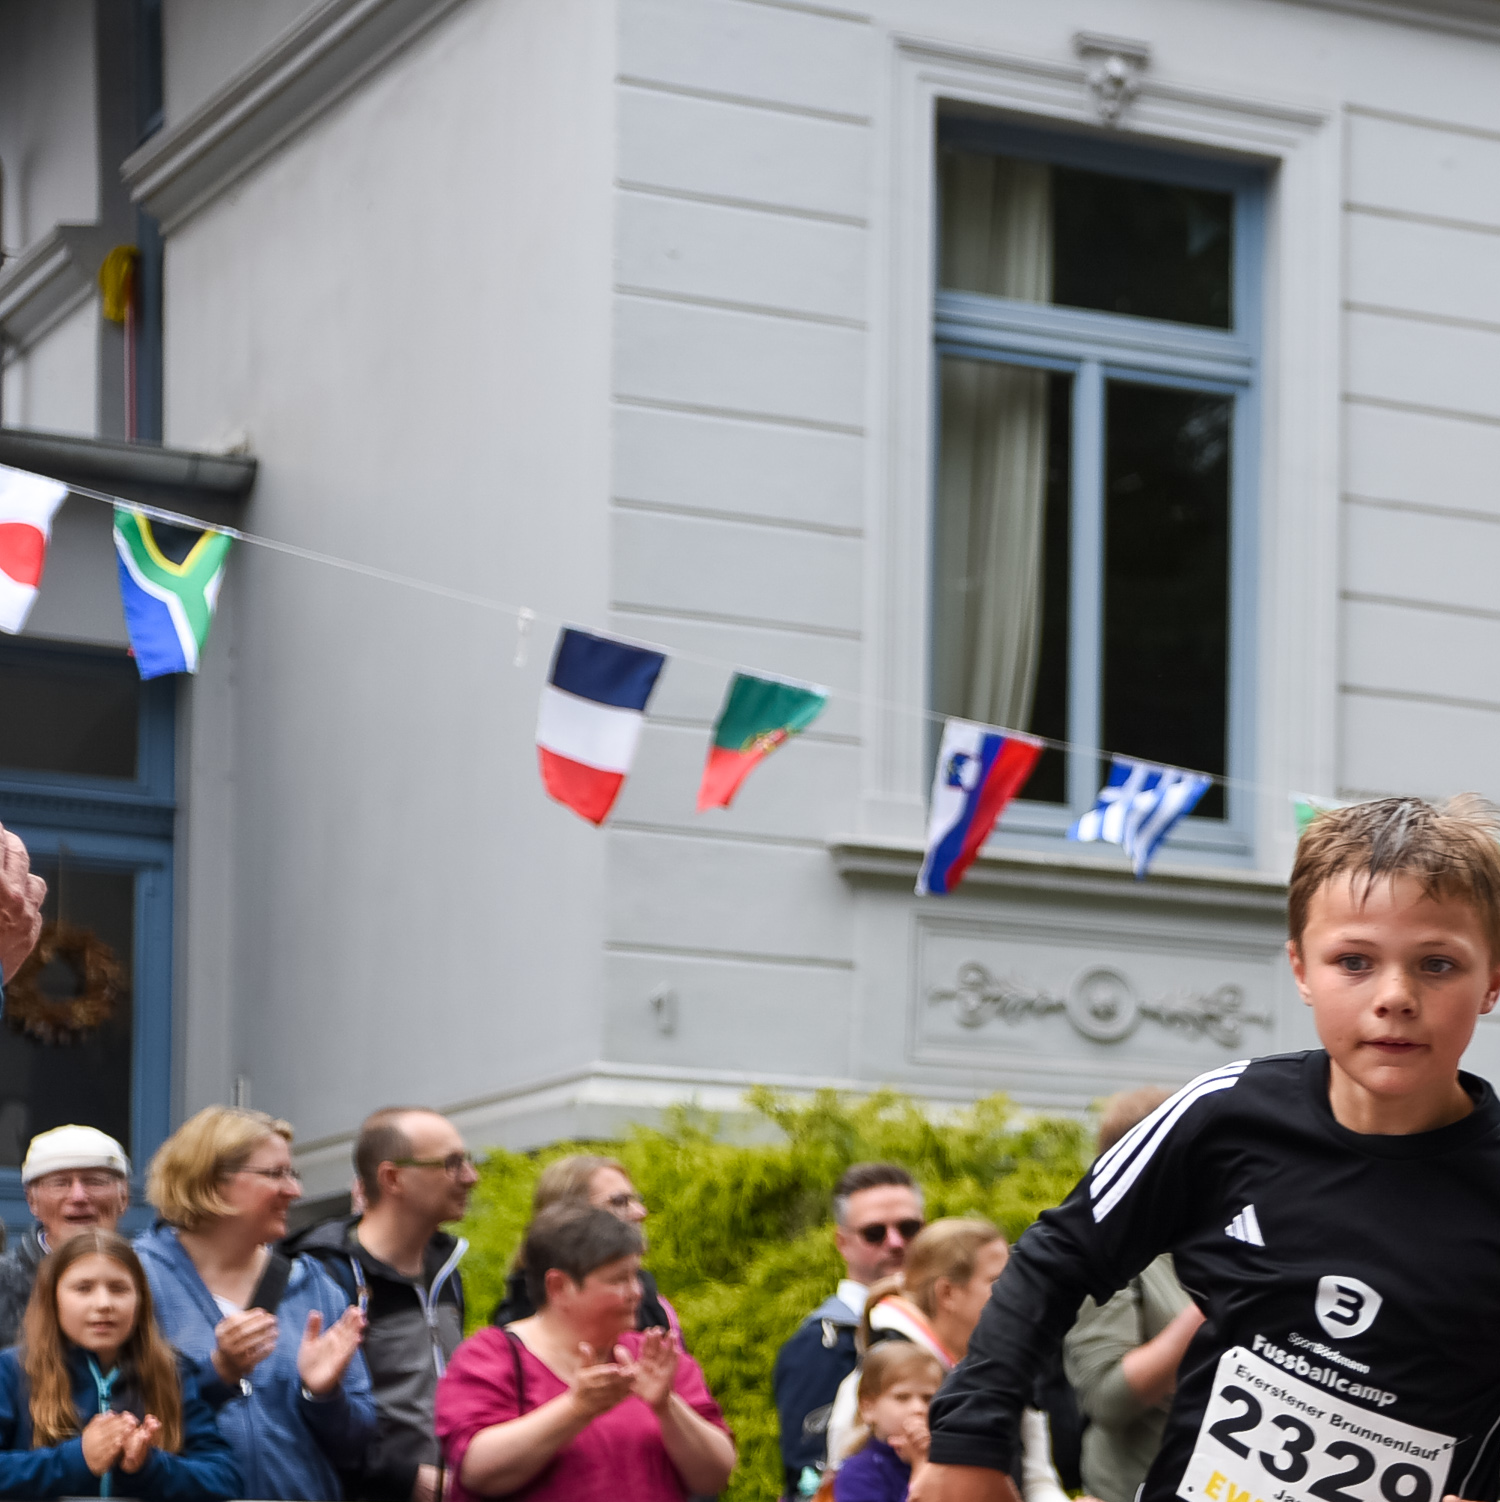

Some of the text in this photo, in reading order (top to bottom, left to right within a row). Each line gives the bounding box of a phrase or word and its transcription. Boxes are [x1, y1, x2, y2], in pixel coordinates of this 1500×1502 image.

[1234, 1364, 1440, 1462] Everstener Brunnenlauf
[1252, 1333, 1398, 1407] Fussballcamp
